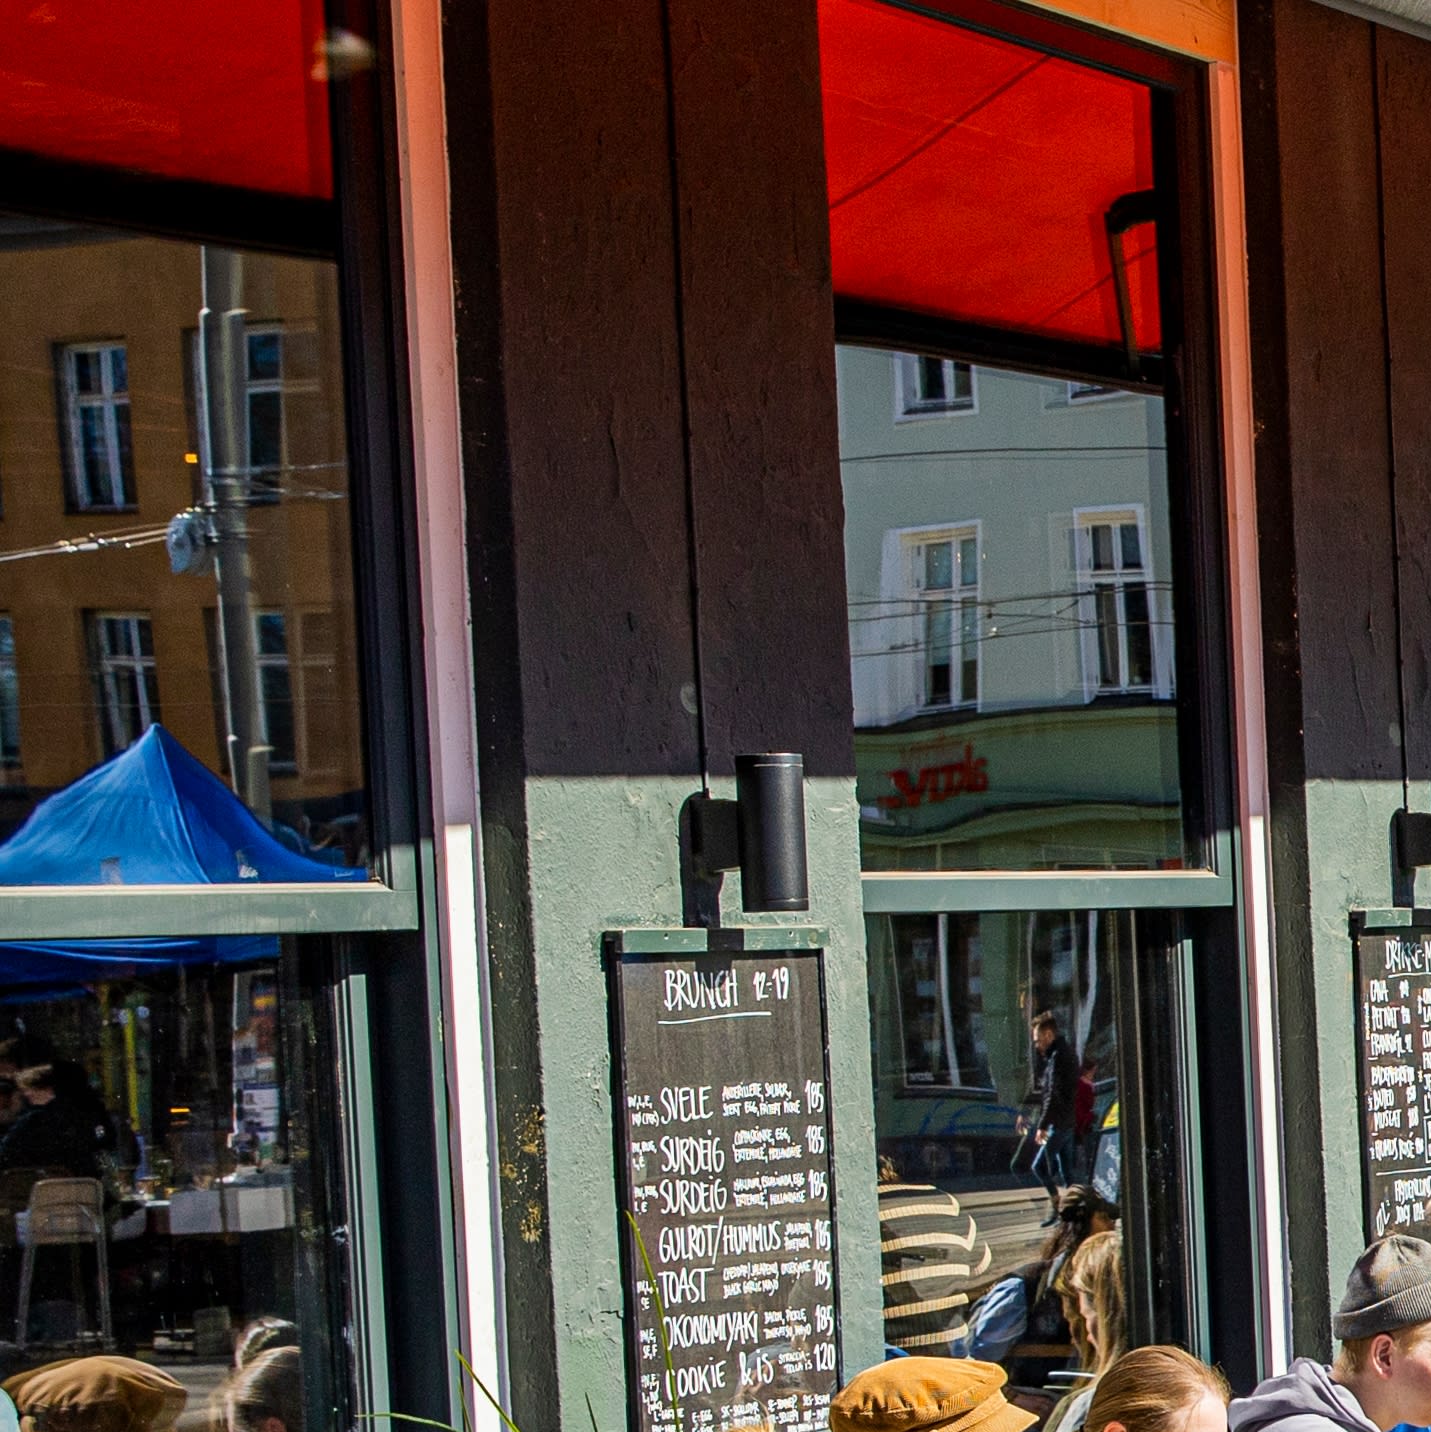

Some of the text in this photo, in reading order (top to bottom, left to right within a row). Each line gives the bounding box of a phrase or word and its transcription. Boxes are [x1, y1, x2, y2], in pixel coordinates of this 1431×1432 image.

[663, 966, 789, 1012] BRUNCH 12-19
[660, 1086, 714, 1125] SVELE
[804, 1079, 825, 1115] 185
[660, 1128, 726, 1175] SURDEIG
[660, 1175, 728, 1217] SURDEIG
[657, 1266, 715, 1309] TOAST
[812, 1258, 832, 1292] 185
[662, 1310, 760, 1352] OKONOMIYAKI
[815, 1304, 834, 1337] 185
[813, 1342, 837, 1373] 120
[665, 1356, 727, 1402] COOKIE
